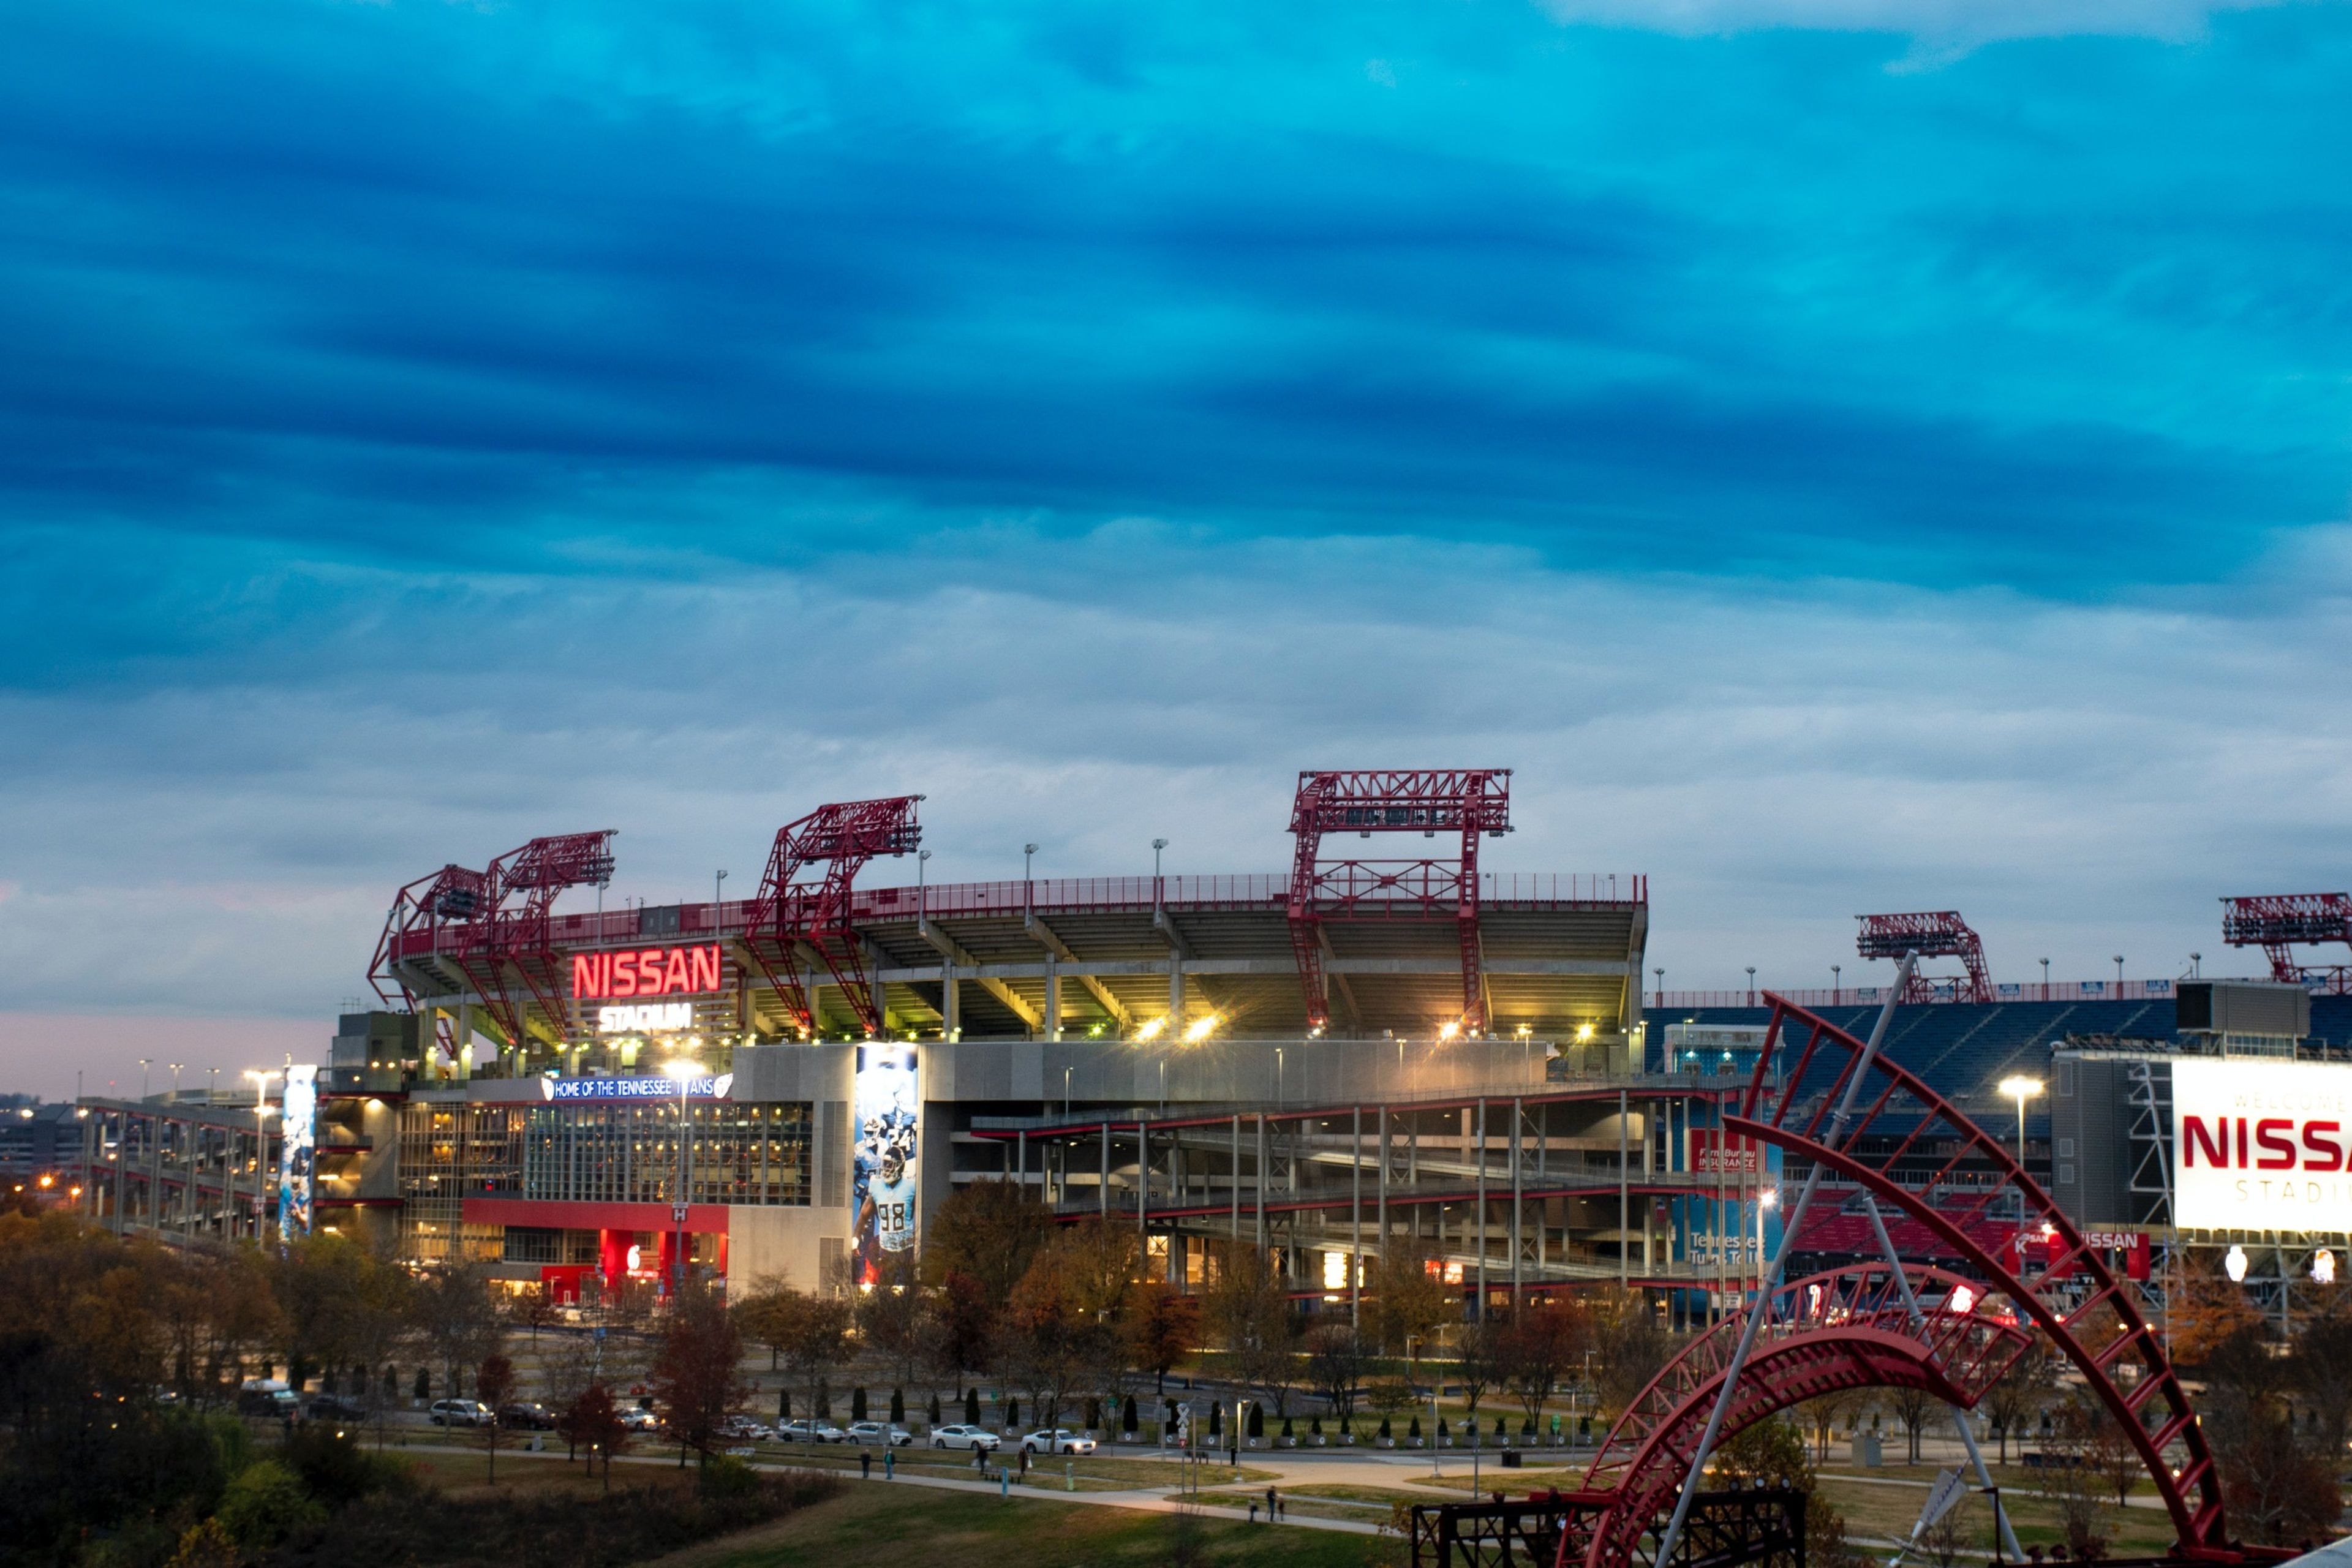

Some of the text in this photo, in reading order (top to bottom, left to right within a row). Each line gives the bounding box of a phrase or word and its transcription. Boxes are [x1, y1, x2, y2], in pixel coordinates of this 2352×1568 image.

[573, 946, 720, 999] NISSAN
[599, 1003, 691, 1031] STADIUM
[555, 1079, 713, 1097] HOME OF THE TENNESSEE TTANS
[2235, 1092, 2345, 1112] WELCOME
[887, 1129, 910, 1152] 24
[2184, 1115, 2352, 1172] NISS
[1725, 1148, 1755, 1158] Burau
[674, 1208, 685, 1221] H
[878, 1203, 905, 1232] 98
[2015, 1240, 2027, 1254] K
[2082, 1233, 2138, 1248] ISSAN
